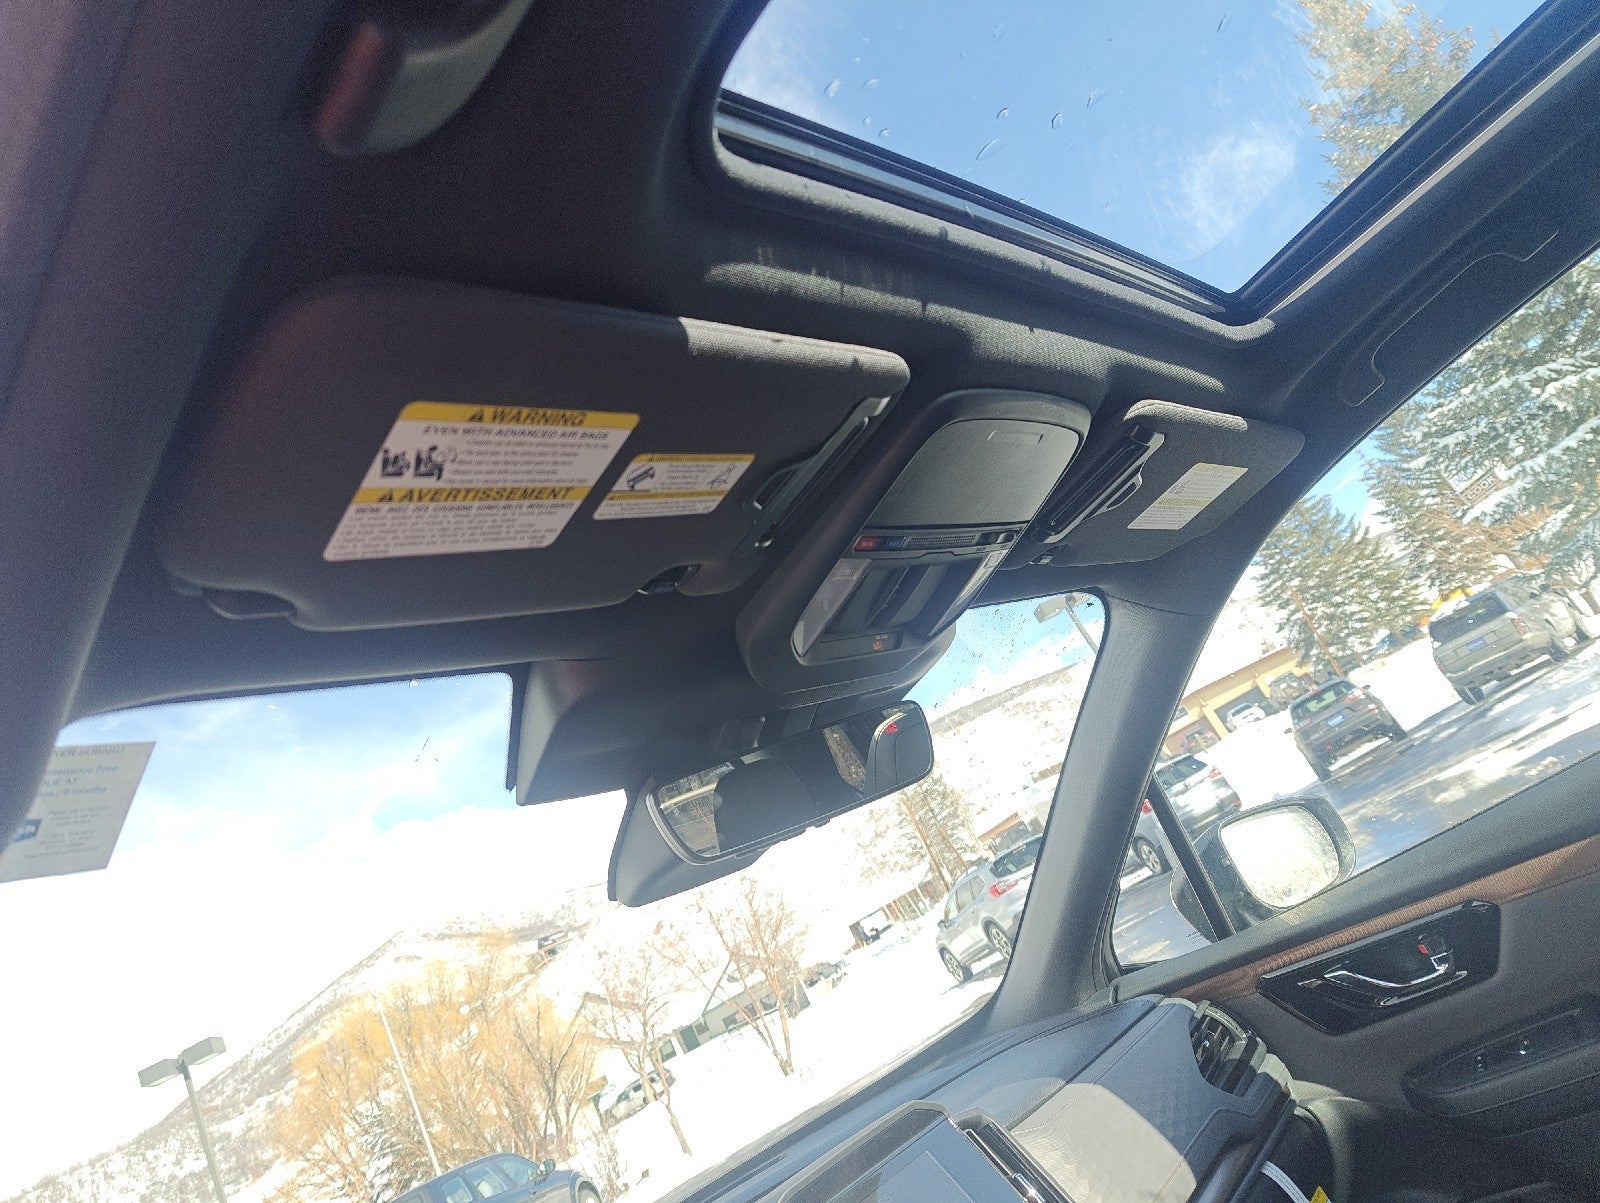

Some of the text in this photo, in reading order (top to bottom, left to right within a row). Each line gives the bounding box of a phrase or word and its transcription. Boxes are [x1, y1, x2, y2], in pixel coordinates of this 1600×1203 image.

[491, 406, 588, 427] WARNING
[423, 425, 459, 435] EVEN
[461, 427, 494, 436] WITH
[495, 428, 558, 438] ADVANCED
[560, 430, 578, 440] AIR
[400, 485, 575, 503] AVERTISSEMENT
